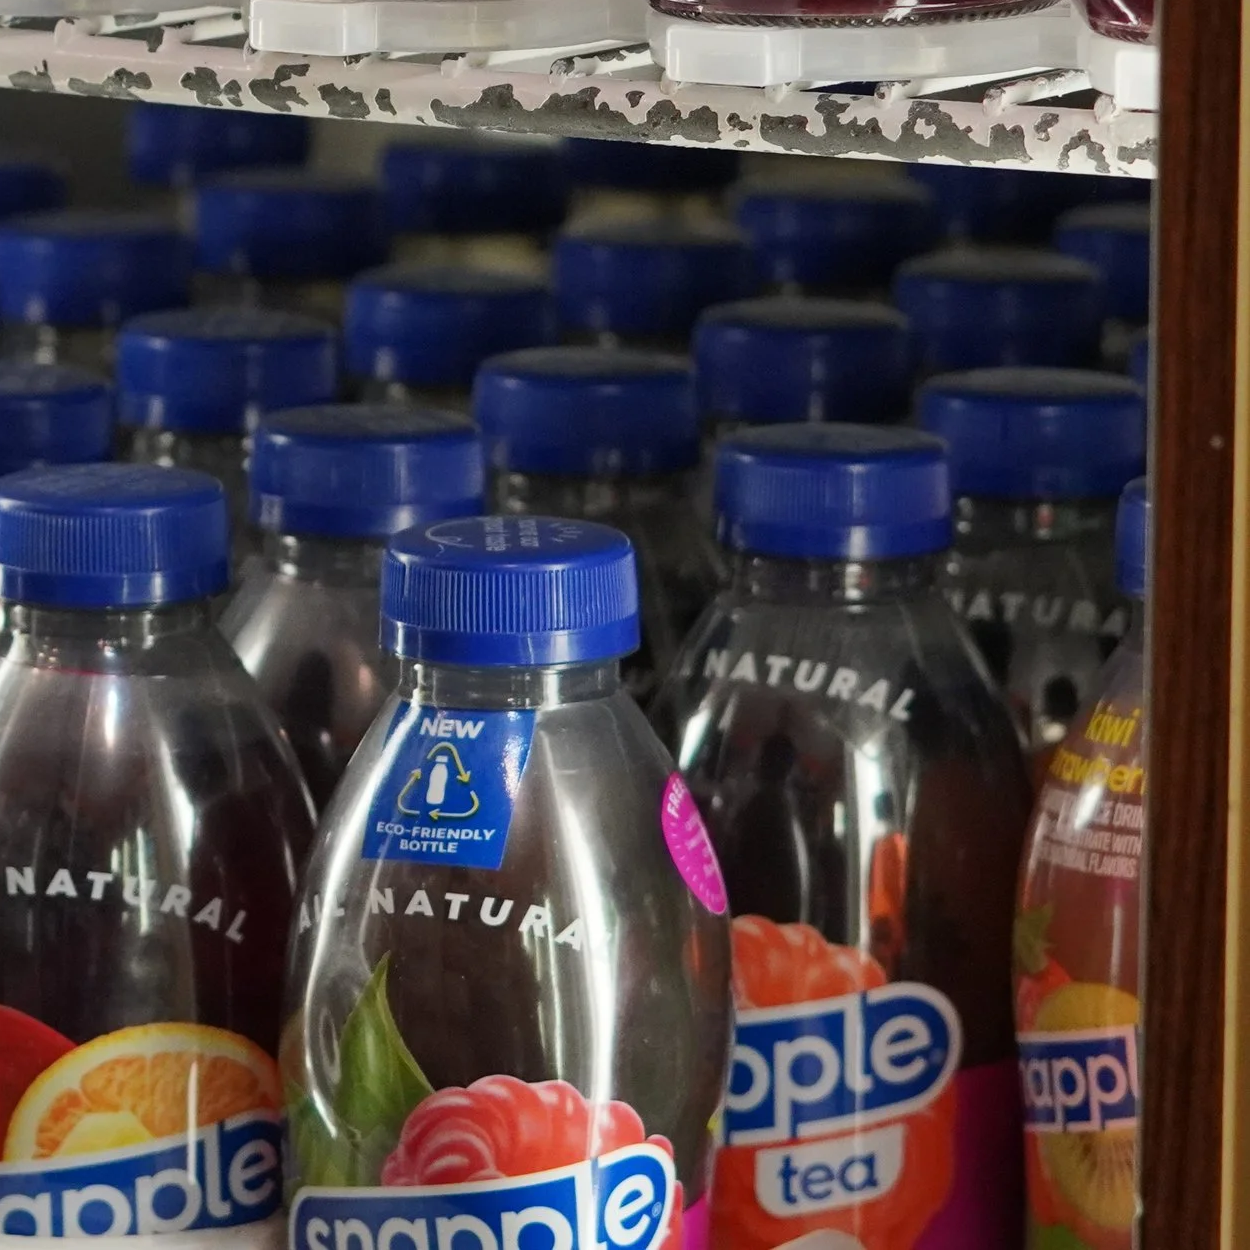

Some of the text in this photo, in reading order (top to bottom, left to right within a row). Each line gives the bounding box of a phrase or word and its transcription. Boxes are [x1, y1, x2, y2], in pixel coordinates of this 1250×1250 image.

[703, 648, 917, 722] NATURAL
[419, 717, 485, 740] NEW
[376, 820, 496, 842] ECO-FRIENDLY
[398, 838, 458, 854] BOTTLE
[5, 865, 249, 945] NATURAL
[777, 1153, 880, 1206] tea
